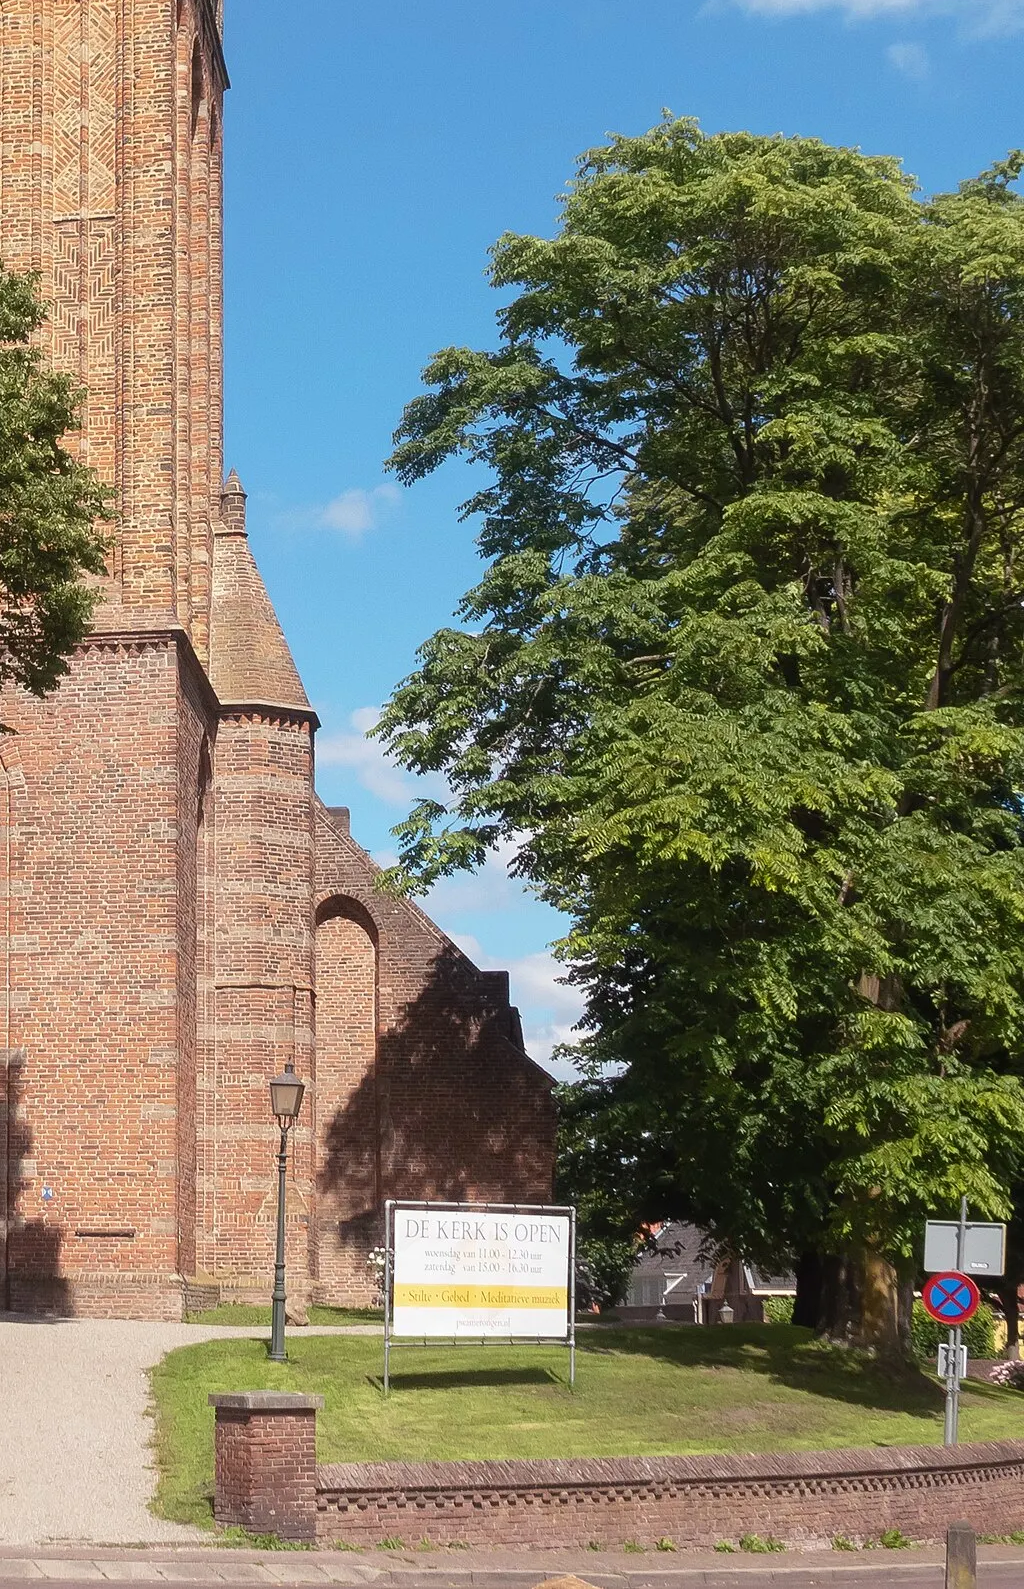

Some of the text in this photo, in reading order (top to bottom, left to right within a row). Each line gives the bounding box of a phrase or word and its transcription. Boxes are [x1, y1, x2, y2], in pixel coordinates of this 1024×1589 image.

[406, 1219, 561, 1243] DE KERK IS OPEN
[424, 1247, 461, 1262] woensdag
[462, 1250, 476, 1260] van
[478, 1248, 501, 1260] 11.00
[508, 1249, 529, 1260] 12.30
[530, 1252, 543, 1260] uur
[424, 1261, 456, 1275] zaterdag
[462, 1263, 476, 1273] van
[478, 1262, 501, 1273] 15.00
[508, 1263, 529, 1274] 16.30
[530, 1266, 543, 1274] uur
[408, 1290, 560, 1304] Stilte Gebed Meditatieve muziek
